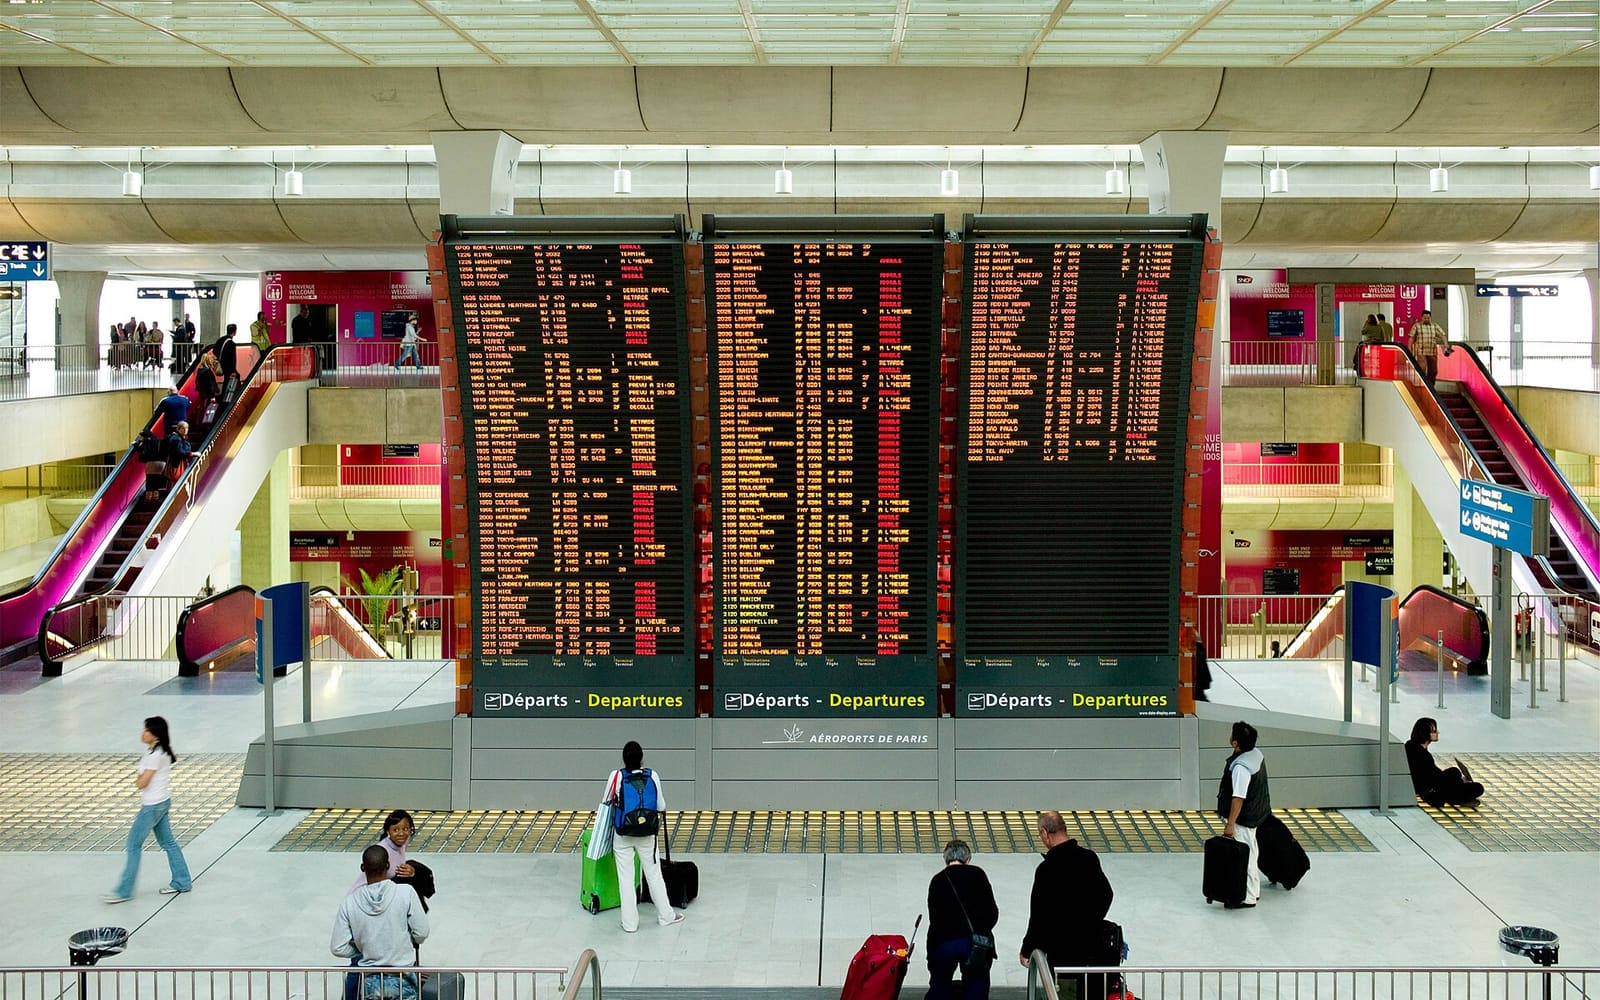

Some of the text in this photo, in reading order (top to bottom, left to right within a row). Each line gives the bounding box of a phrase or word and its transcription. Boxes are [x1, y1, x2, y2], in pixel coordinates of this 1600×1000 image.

[503, 692, 568, 710] Départs
[588, 693, 683, 710] Departures
[743, 693, 809, 710] Départs
[830, 693, 925, 710] Departures
[986, 693, 1052, 710] Départs
[1072, 693, 1168, 710] Departures
[810, 733, 928, 743] AÉROPORTS DE PARIS
